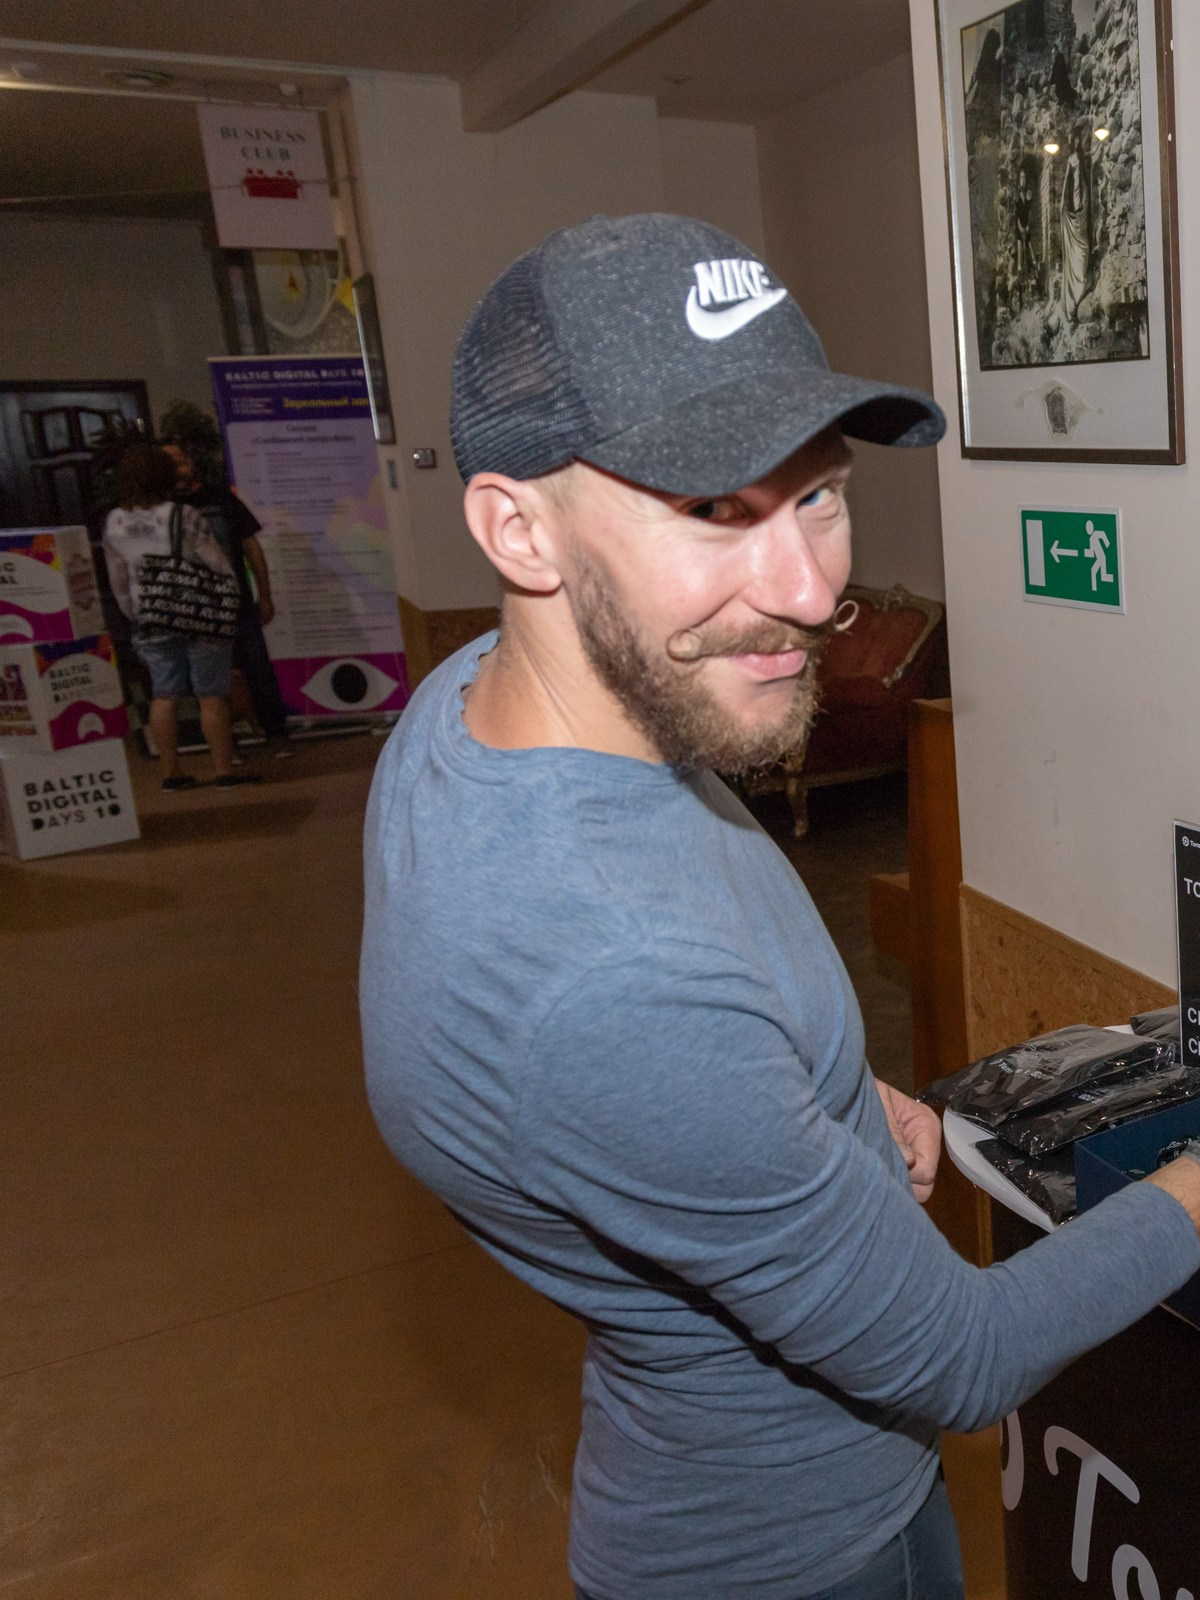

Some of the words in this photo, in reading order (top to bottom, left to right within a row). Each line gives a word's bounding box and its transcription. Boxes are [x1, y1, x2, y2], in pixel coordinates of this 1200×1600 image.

[220, 126, 306, 143] BUSINESS
[241, 146, 290, 161] CLUB
[694, 259, 769, 307] NIKE
[226, 371, 270, 382] BALTIC
[273, 370, 318, 380] DIGITAL
[48, 662, 90, 679] BALTIC
[50, 676, 92, 692] DIGITAL
[23, 770, 116, 798] BALTIC
[27, 788, 119, 815] DIGITAL
[31, 809, 86, 831] DAYS
